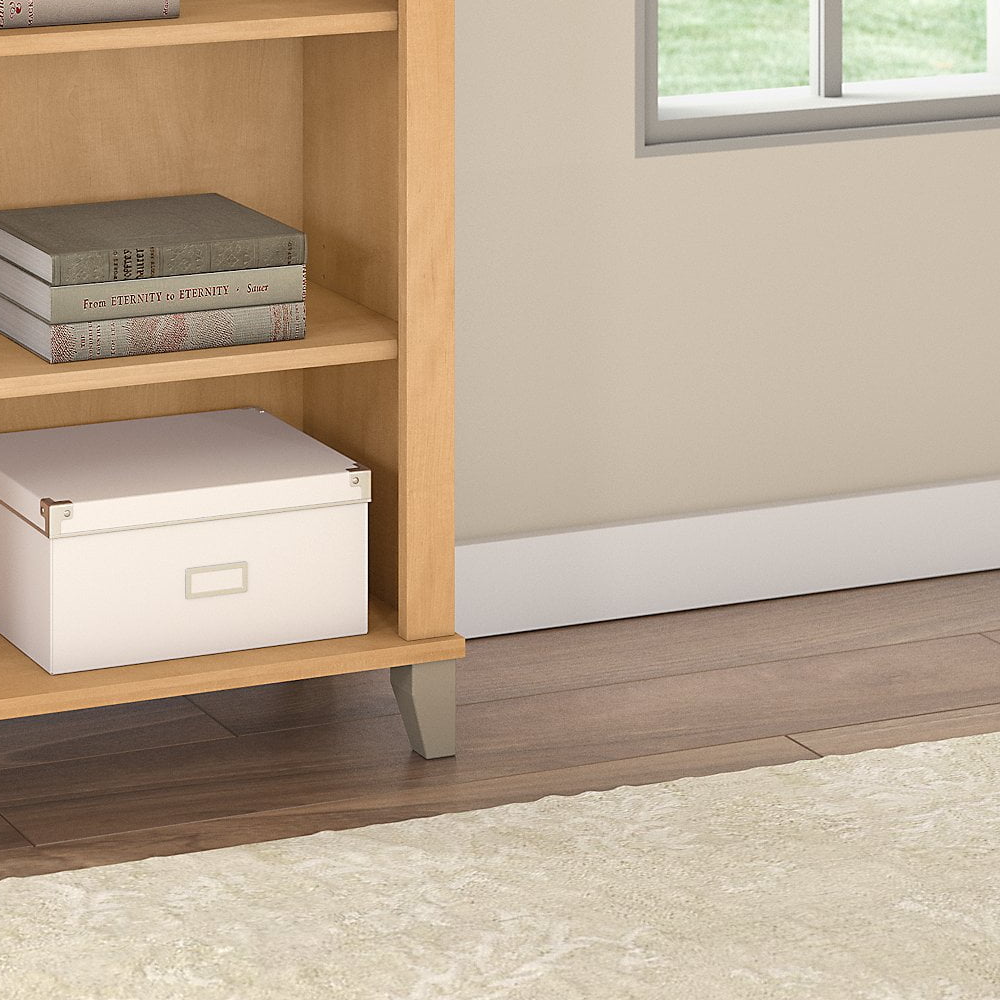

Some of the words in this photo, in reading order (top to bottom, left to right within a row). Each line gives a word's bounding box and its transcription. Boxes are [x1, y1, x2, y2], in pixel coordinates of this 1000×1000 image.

[83, 298, 107, 310] From
[110, 291, 163, 307] ETERNITY
[166, 293, 176, 301] to
[179, 285, 230, 300] ETERNITY
[246, 283, 269, 294] Sauer
